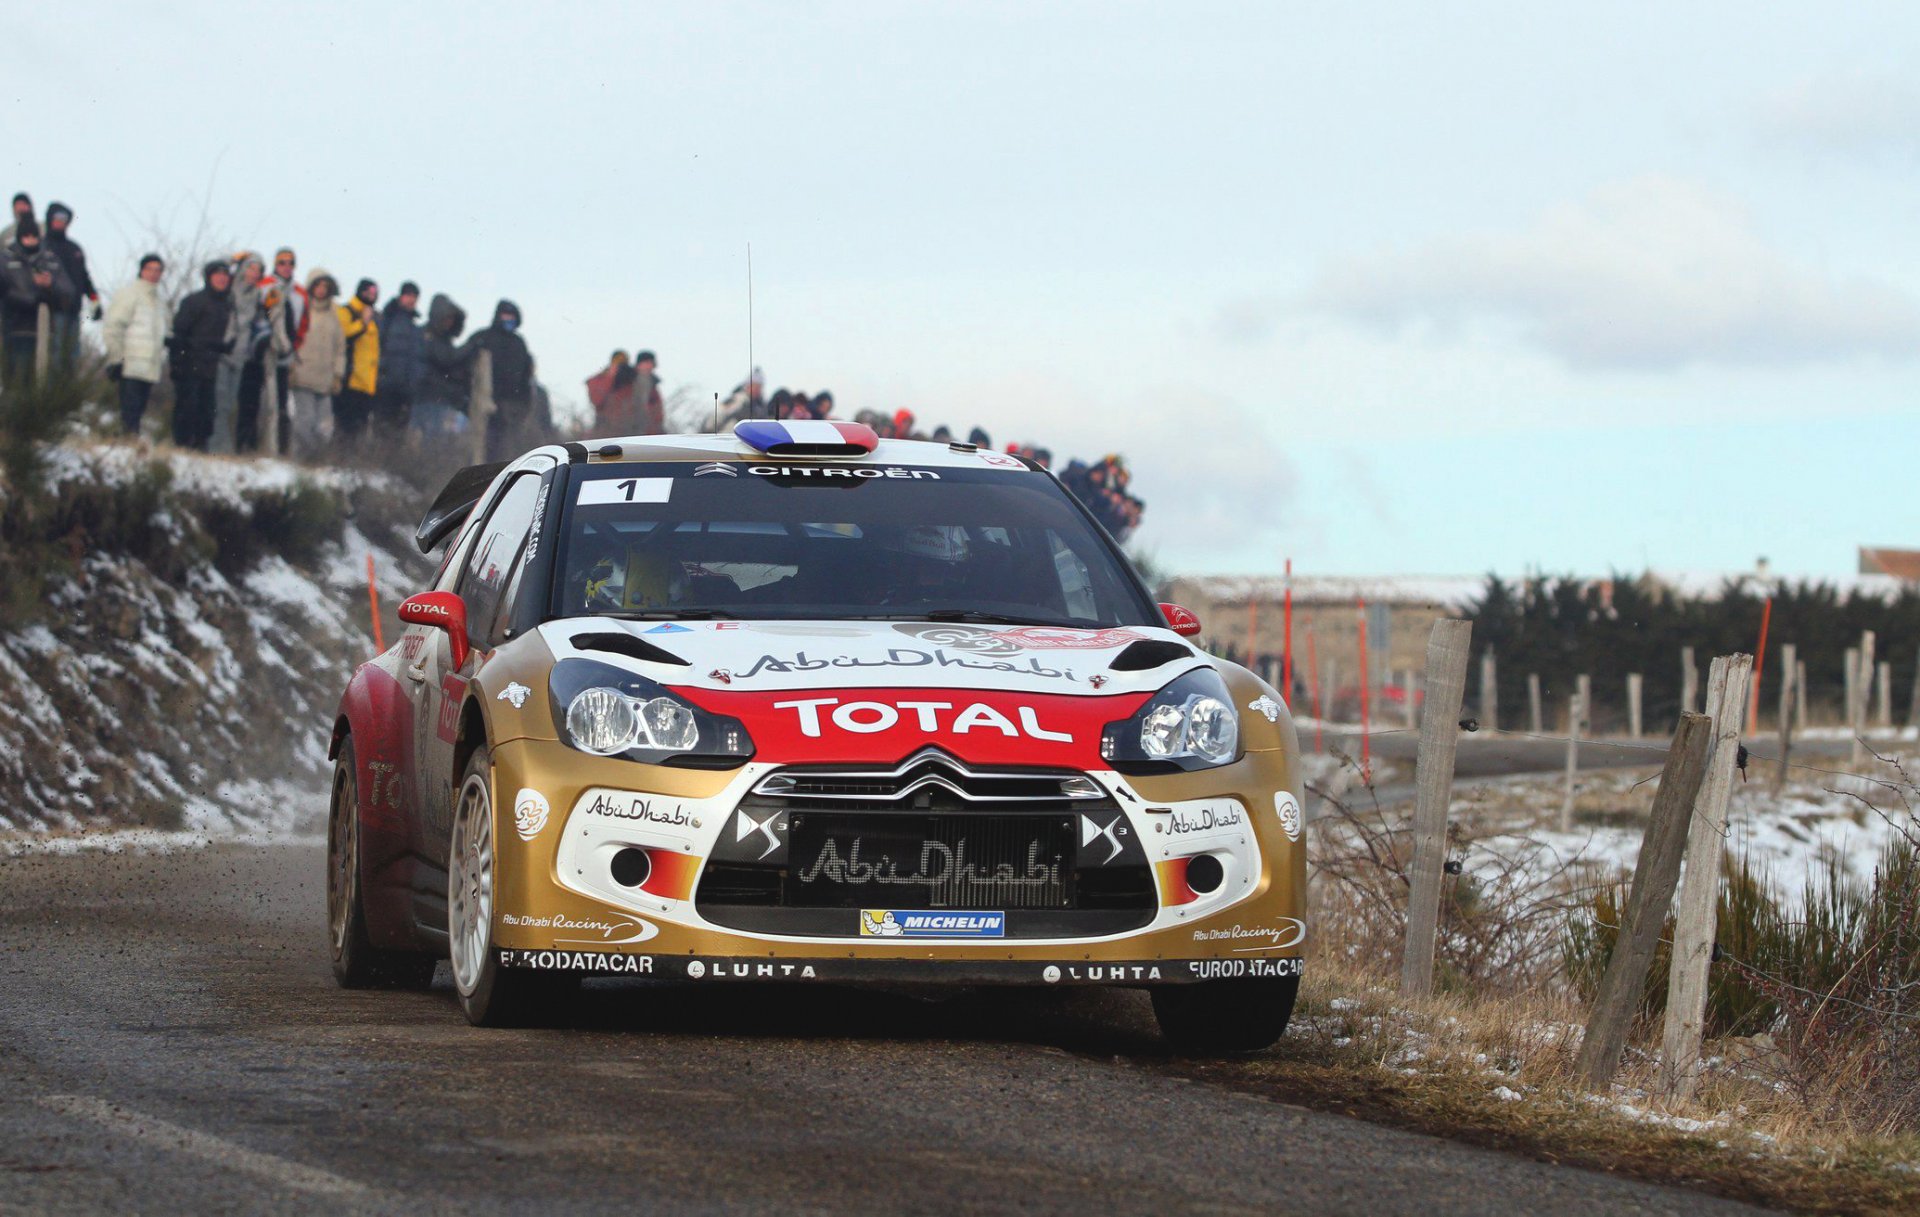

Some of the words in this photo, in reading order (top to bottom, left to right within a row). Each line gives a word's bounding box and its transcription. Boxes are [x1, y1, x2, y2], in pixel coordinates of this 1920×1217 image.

[748, 465, 940, 481] CITROËN
[617, 479, 637, 501] 1
[406, 602, 449, 615] TOTAL
[773, 697, 1074, 744] TOTAL
[502, 913, 519, 926] Abu
[521, 915, 551, 928] Dhabi
[552, 913, 633, 937] Racing
[904, 916, 1001, 929] MICHELIN
[1193, 929, 1208, 941] Abu
[1209, 927, 1232, 941] Dhabi
[1231, 924, 1296, 944] Racing
[712, 964, 816, 978] LUHTA
[1069, 966, 1162, 981] LUHTA
